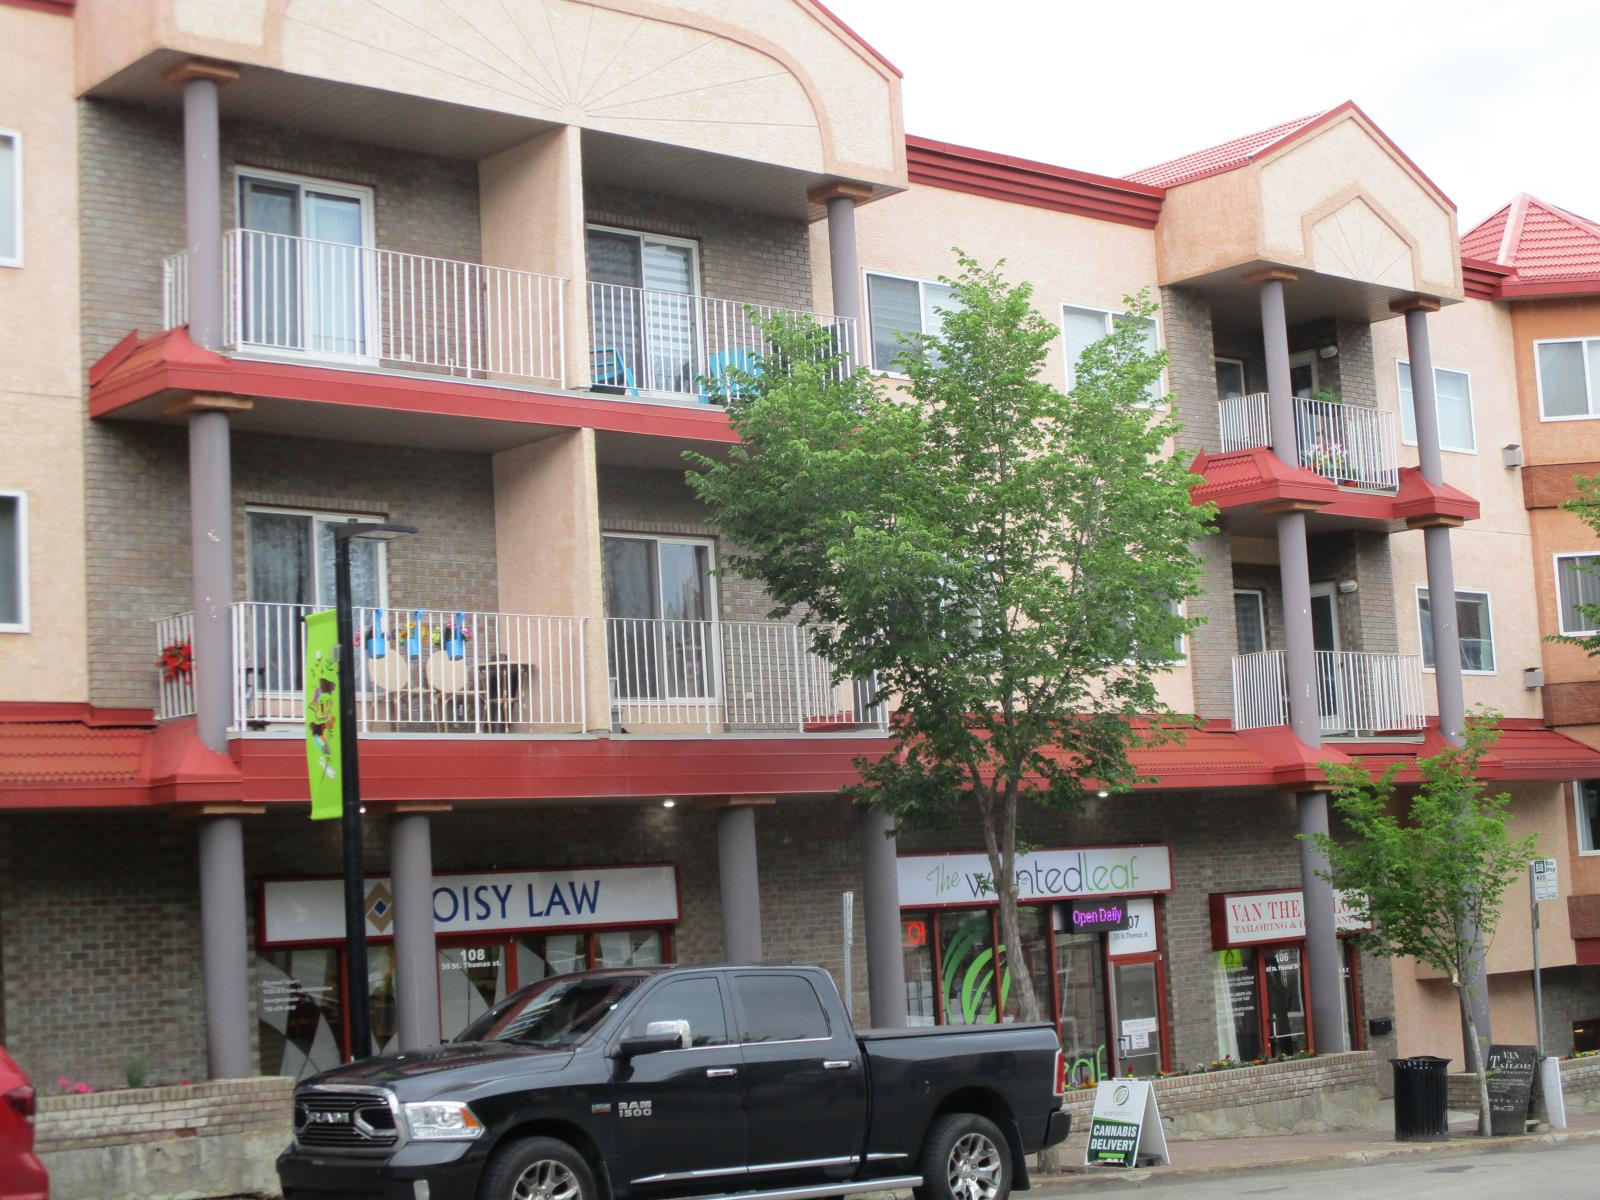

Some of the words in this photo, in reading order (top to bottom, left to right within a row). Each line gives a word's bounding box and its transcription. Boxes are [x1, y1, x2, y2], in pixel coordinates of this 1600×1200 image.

[927, 863, 961, 896] The
[432, 884, 513, 923] OISY
[527, 880, 600, 918] LAW
[1072, 909, 1098, 927] Open
[1099, 907, 1122, 924] Daily
[1232, 904, 1262, 922] VAN
[1267, 899, 1301, 920] THE
[1128, 915, 1140, 929] 07
[1233, 921, 1288, 934] TAILORING
[460, 948, 486, 961] 108
[1489, 1055, 1532, 1069] TAILOR
[1503, 1051, 1519, 1060] VAN
[618, 1101, 652, 1110] RAM
[308, 1112, 349, 1123] RAM
[619, 1108, 652, 1118] 1500
[1093, 1125, 1137, 1137] CANNABIS
[1091, 1139, 1134, 1151] DELIVERY
